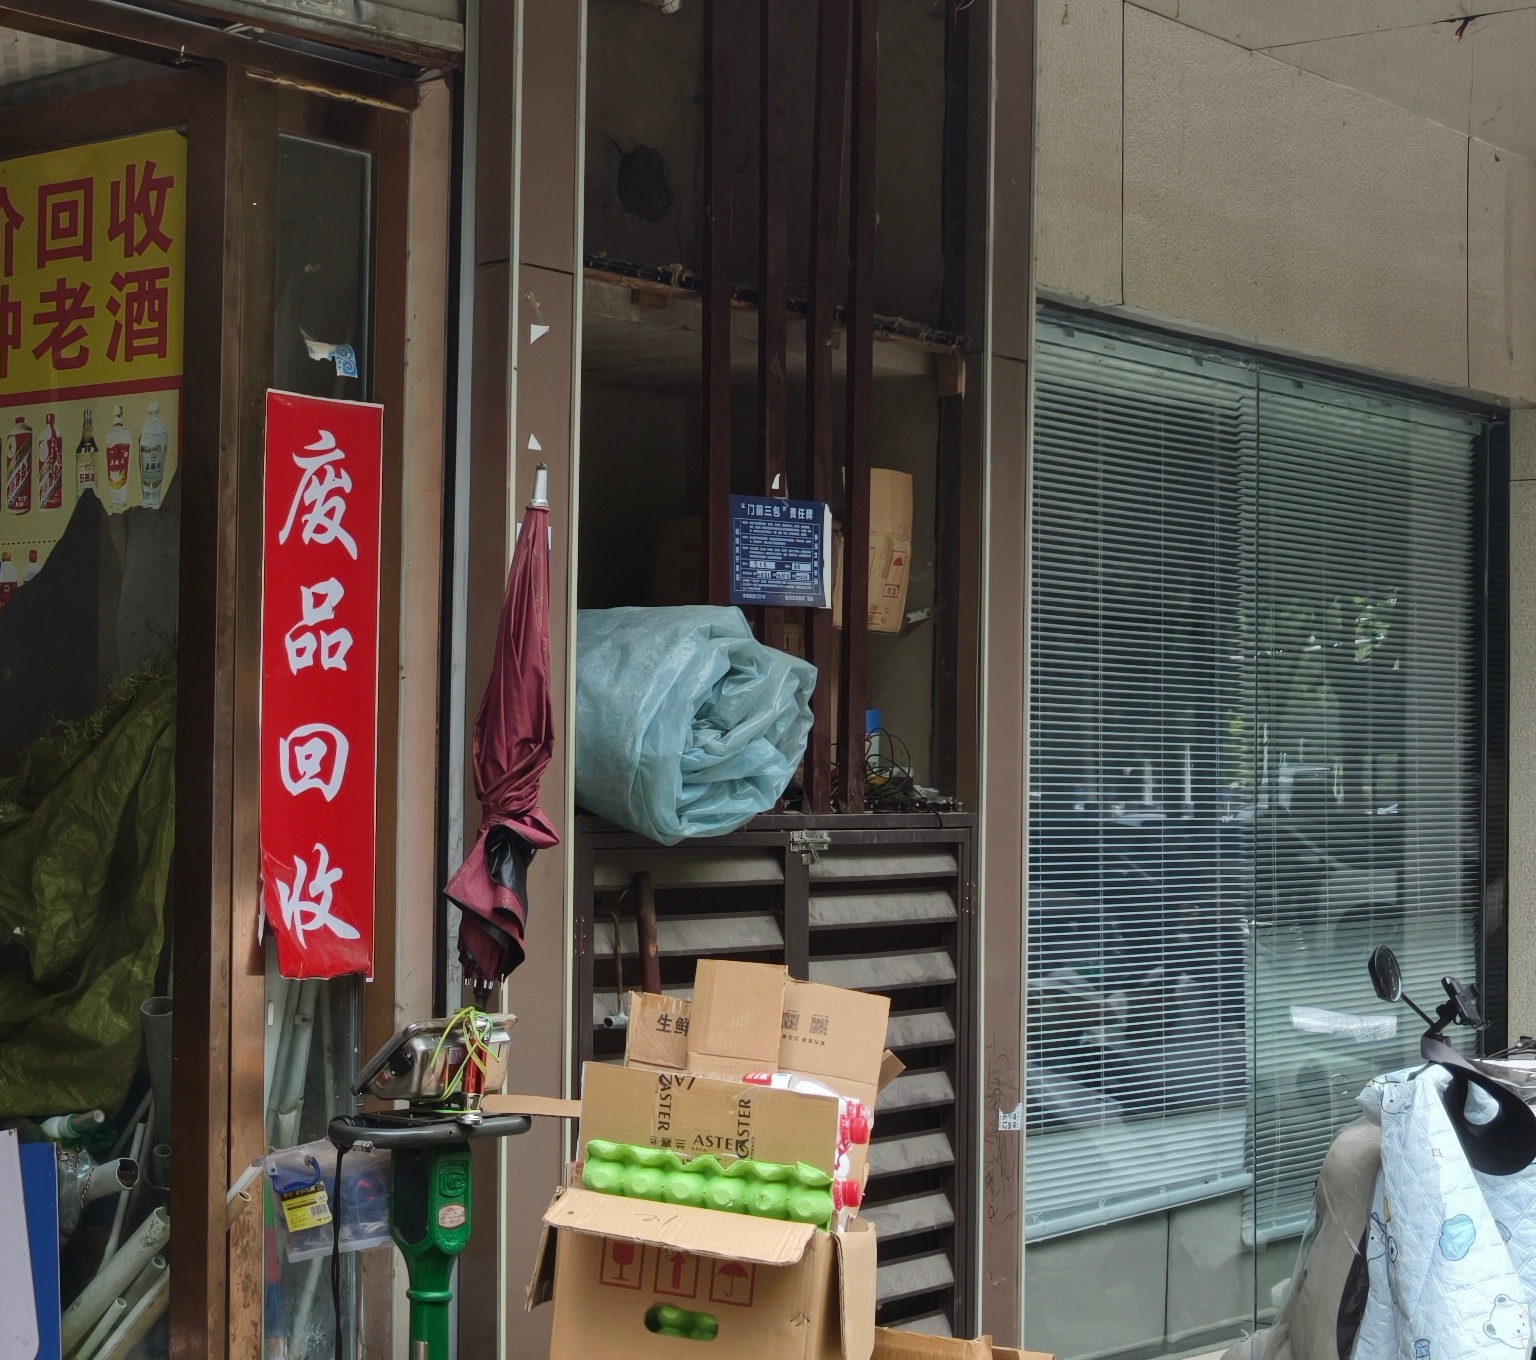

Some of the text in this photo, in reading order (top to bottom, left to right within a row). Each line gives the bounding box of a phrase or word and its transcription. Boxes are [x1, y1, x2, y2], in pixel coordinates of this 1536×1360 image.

[278, 429, 363, 951] 废品回收
[655, 1013, 690, 1038] 生鲜
